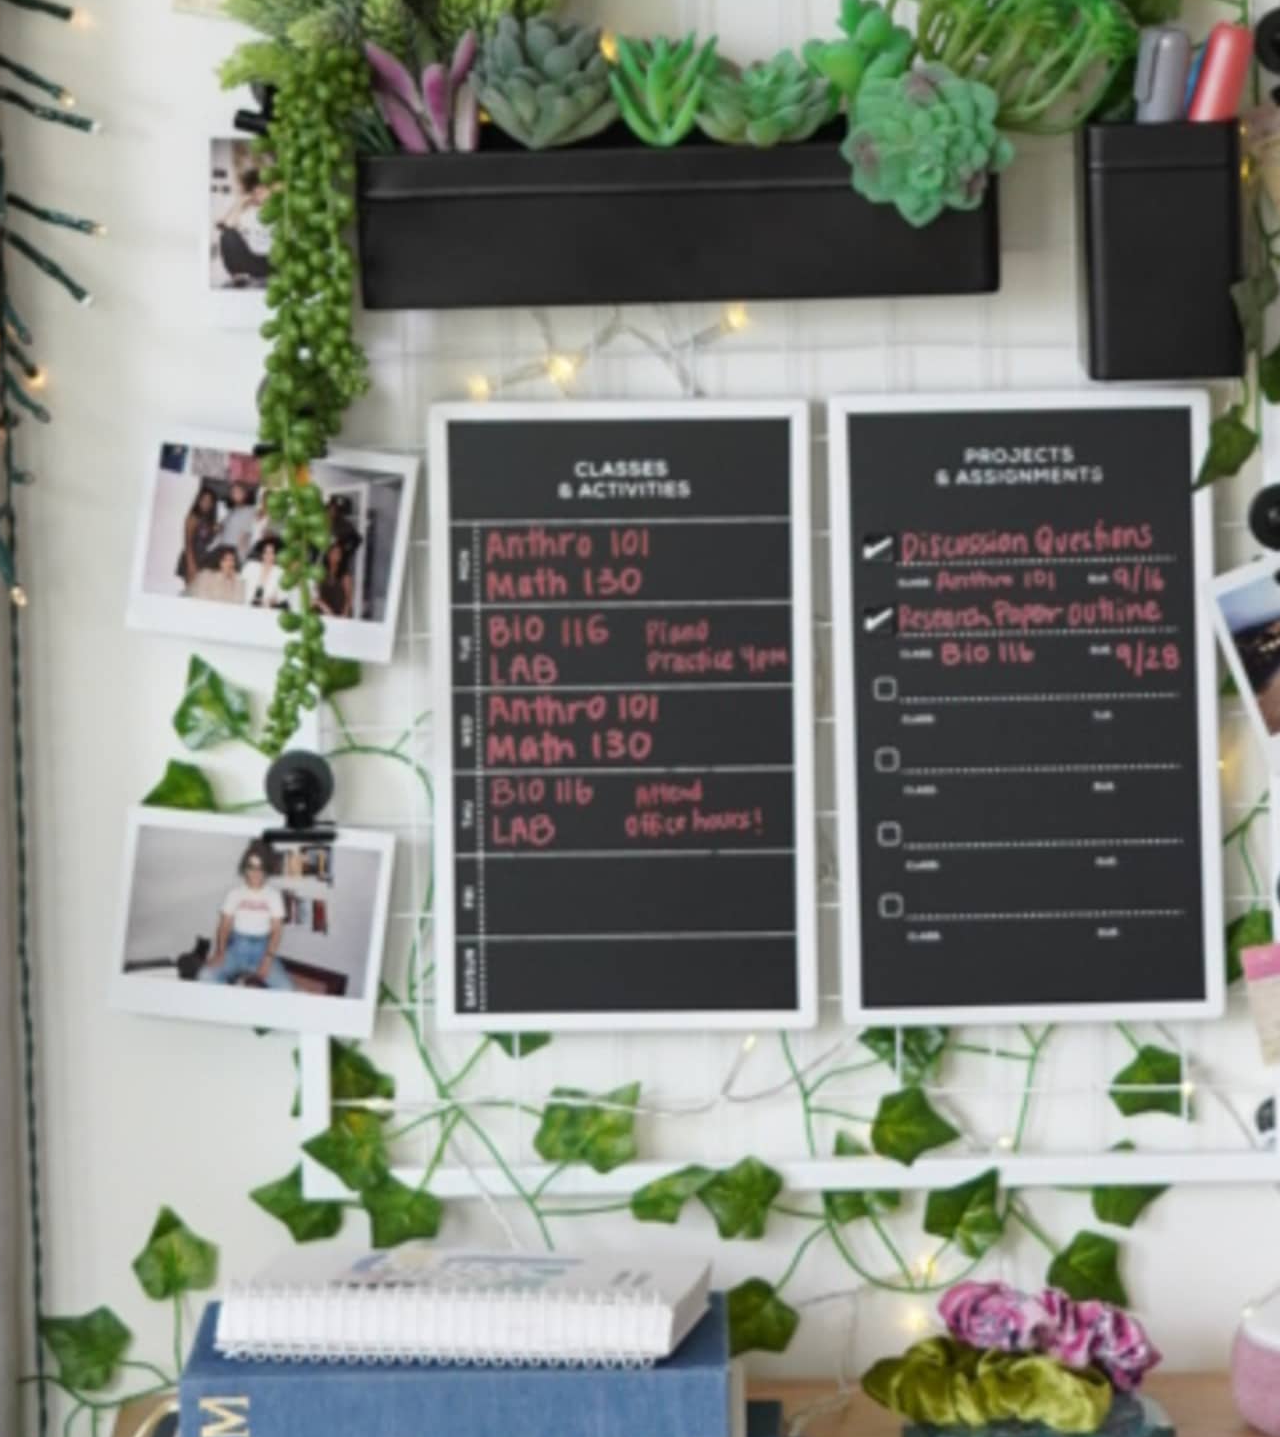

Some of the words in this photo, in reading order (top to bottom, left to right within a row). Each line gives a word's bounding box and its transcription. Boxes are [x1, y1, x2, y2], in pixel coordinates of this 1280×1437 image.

[573, 459, 669, 479] CLASSES
[964, 446, 1075, 464] PROJECTS
[557, 481, 573, 500] &
[577, 479, 691, 499] ACTIVITIES
[935, 469, 950, 486] &
[955, 465, 1103, 485] ASSIGNMENTS
[486, 527, 593, 565] Anthro
[611, 529, 650, 558] 101
[1034, 518, 1153, 558] Questions
[485, 563, 569, 600] Math
[583, 565, 642, 599] 130
[1024, 567, 1056, 589] 101
[1113, 564, 1165, 592] 9/16
[561, 613, 610, 648] 116
[490, 650, 559, 685] LAB
[1115, 640, 1180, 677] 9/28
[618, 692, 659, 722] 101
[486, 728, 576, 768] Math
[590, 728, 653, 762] 130
[492, 813, 556, 847] LAB
